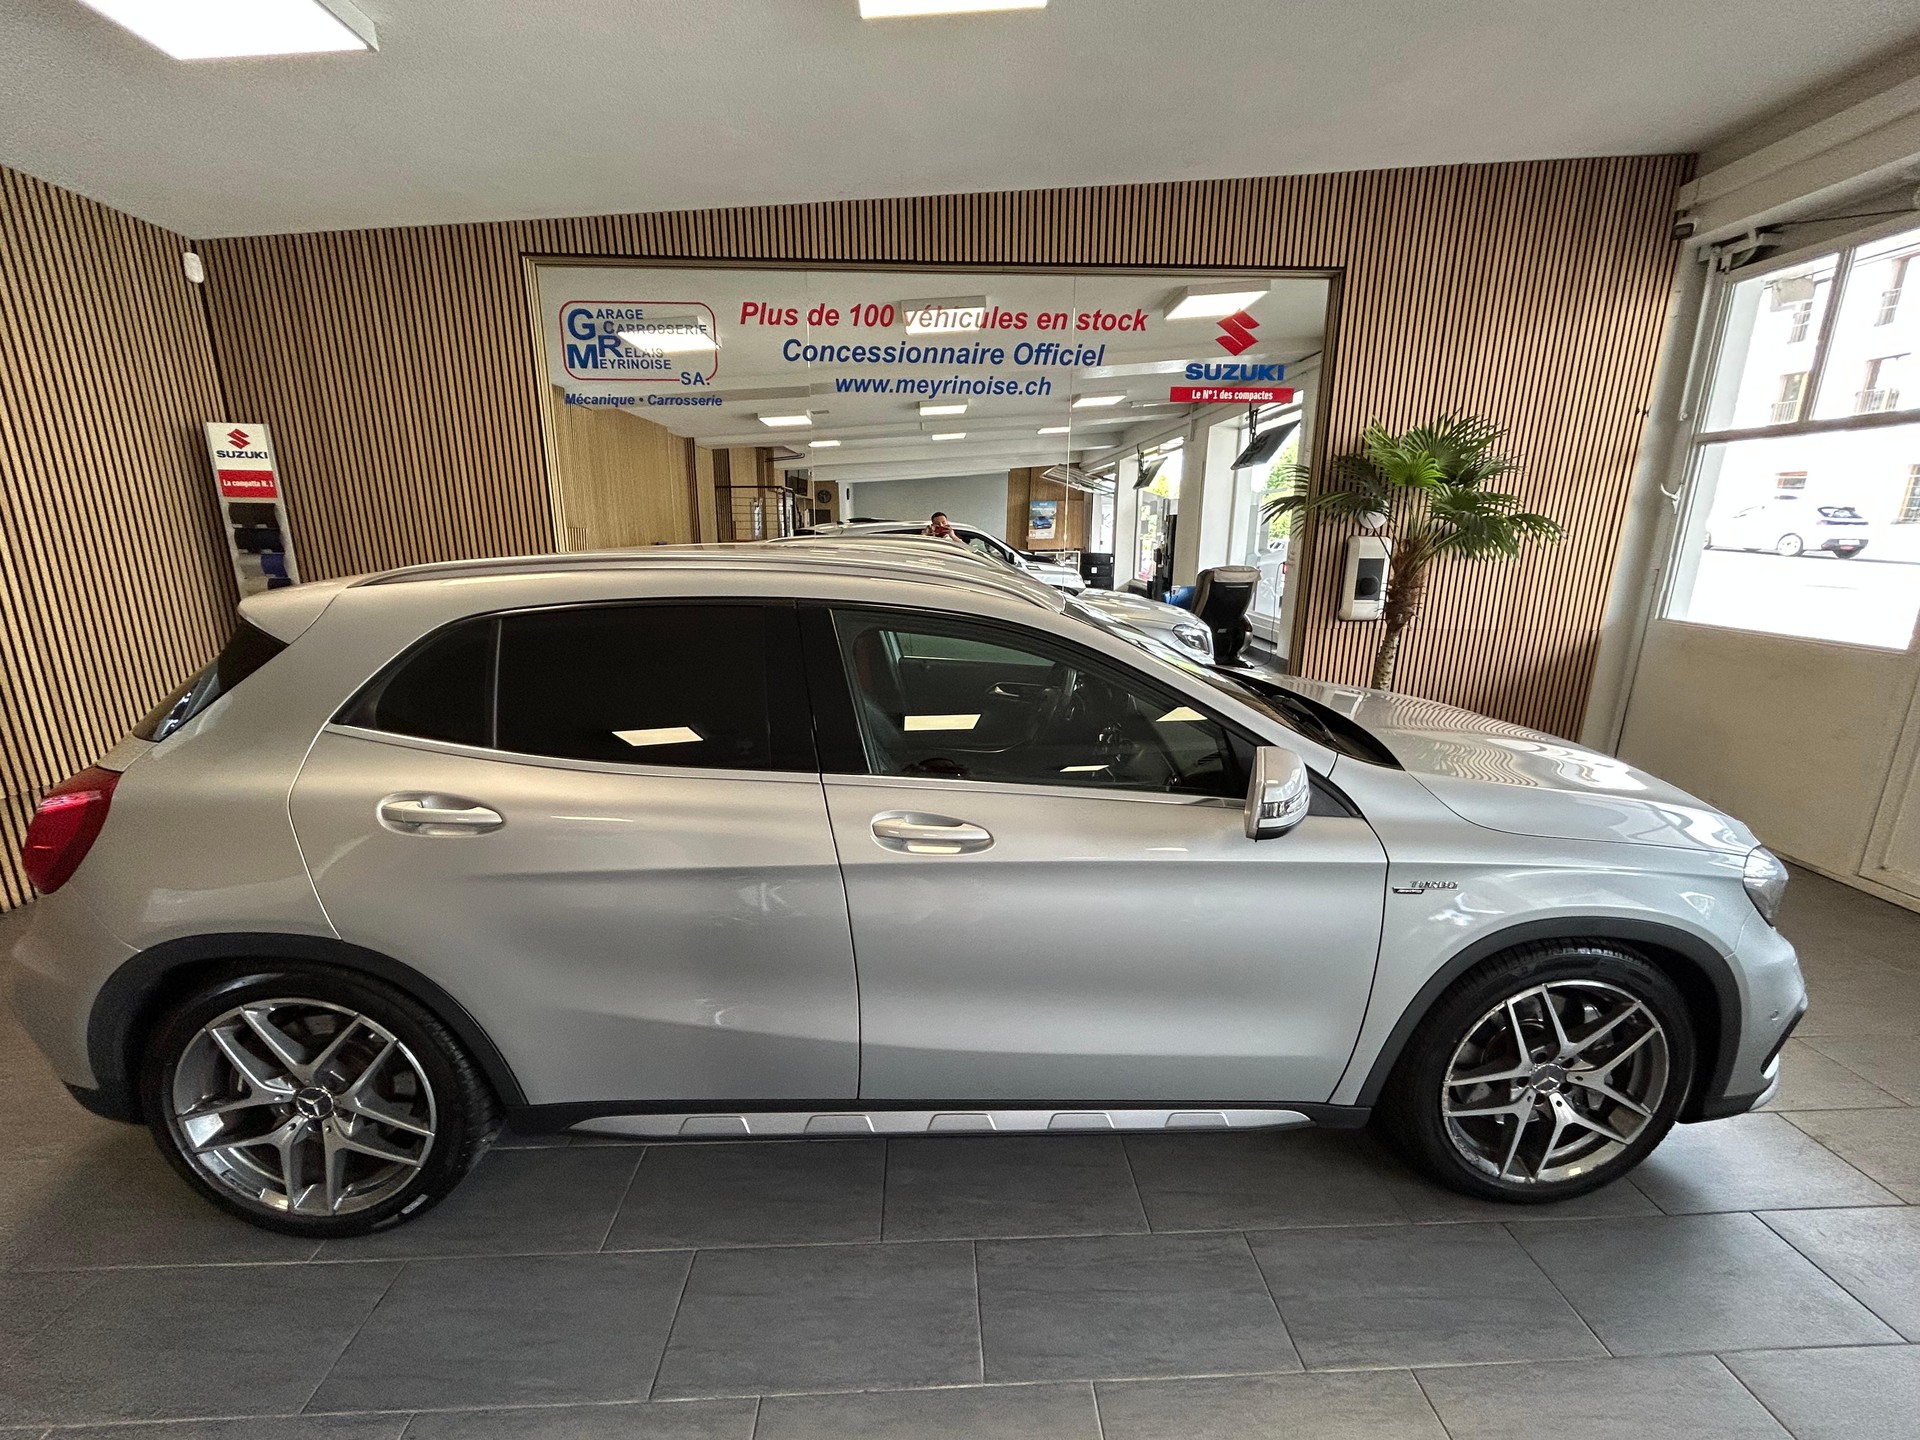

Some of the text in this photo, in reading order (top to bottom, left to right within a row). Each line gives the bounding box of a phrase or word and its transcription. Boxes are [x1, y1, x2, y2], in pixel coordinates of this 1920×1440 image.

[740, 302, 1148, 332] Plus de 100 véhicules en stock
[603, 320, 707, 335] CARROSSERIE
[566, 344, 672, 369] MEYRINOISE
[598, 335, 664, 358] RELAIS
[783, 338, 1106, 368] Concessionnaire Officiel
[1185, 363, 1284, 380] SUZUKI
[835, 376, 1053, 400] www.meyrinoise.ch
[1192, 389, 1202, 400] Le
[1219, 390, 1233, 400] des
[1234, 390, 1273, 402] compactes
[565, 393, 723, 408] Mécanique Carrosserie
[216, 450, 268, 459] SUZUKI
